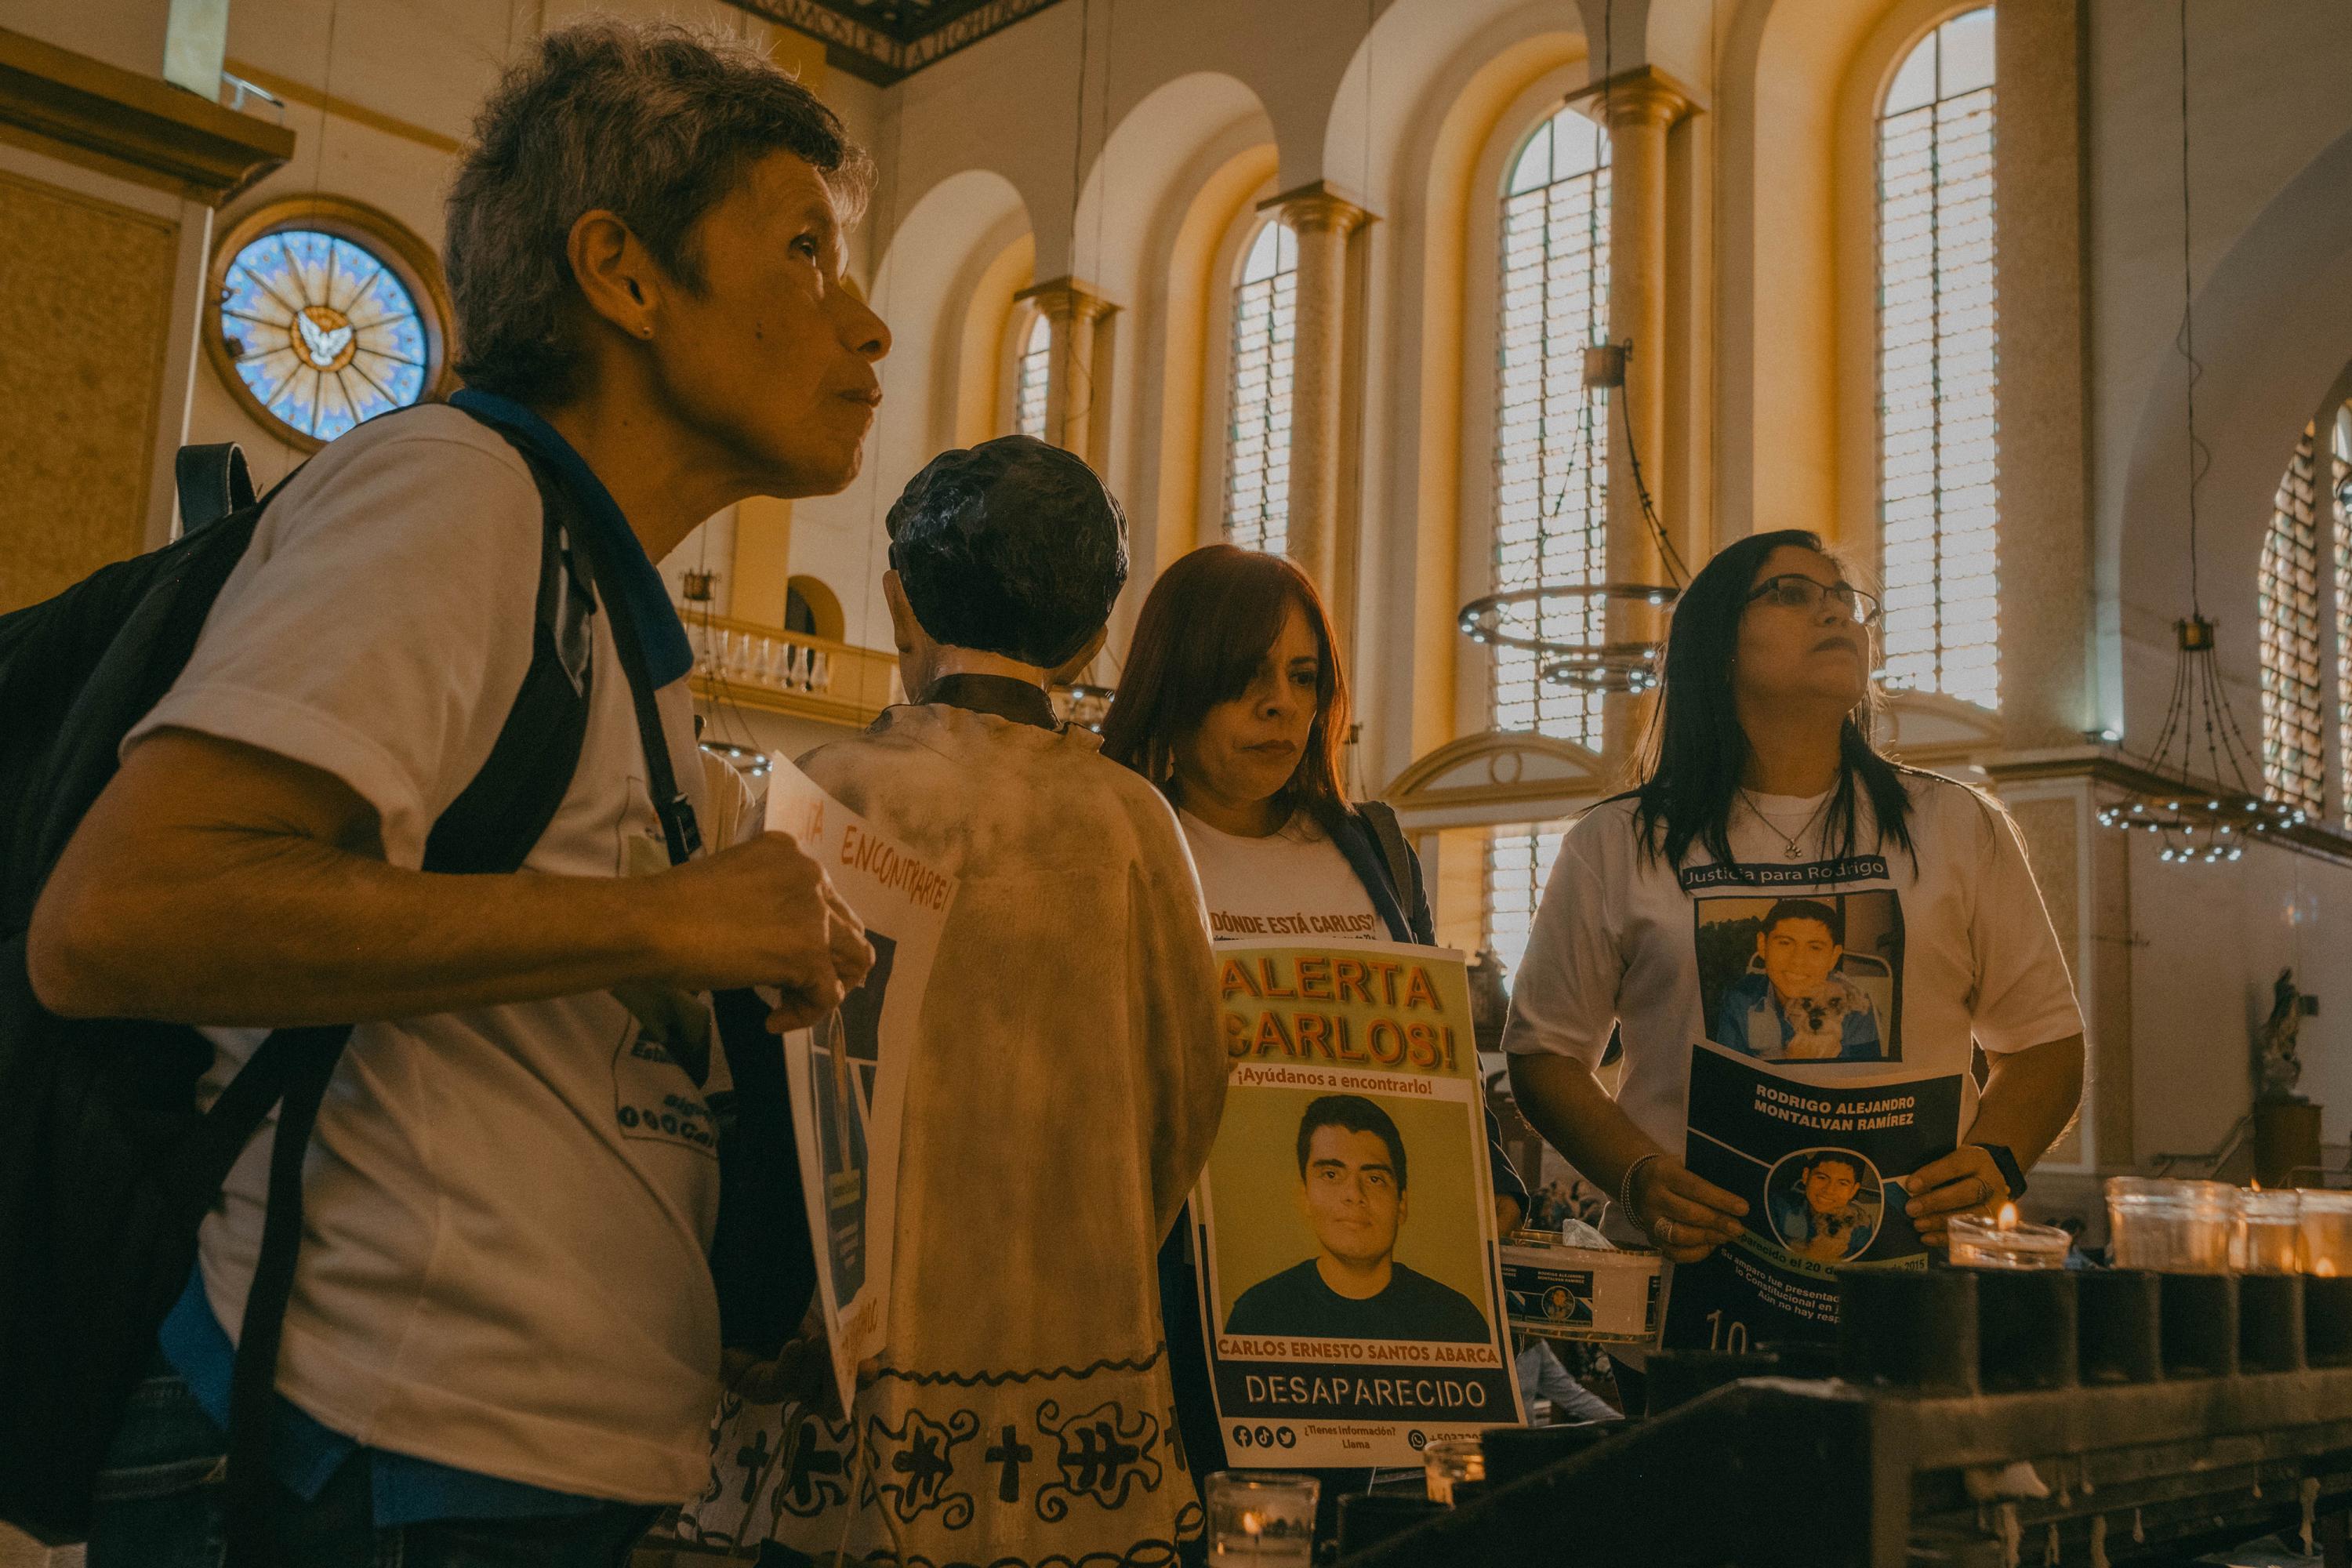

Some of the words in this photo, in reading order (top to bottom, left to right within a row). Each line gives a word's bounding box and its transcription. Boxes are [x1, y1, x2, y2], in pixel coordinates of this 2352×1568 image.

[1761, 870, 1802, 884] para
[1808, 861, 1884, 880] Rodrigo
[1210, 911, 1268, 934] DÓNDE
[1267, 913, 1311, 934] ESTÁ
[1310, 913, 1375, 934] CARLOS?
[1219, 956, 1442, 1011] ALERTA
[1237, 1068, 1325, 1087] ¡Ayúdanos
[1328, 1076, 1337, 1086] a
[1341, 1075, 1432, 1095] encontrarlo!
[1755, 1084, 1831, 1114] RODRIGO
[1835, 1096, 1915, 1115] ALEJANDRO
[1754, 1099, 1854, 1131] MONTALVAN
[1857, 1112, 1915, 1131] RAMÍREZ
[1720, 1247, 1733, 1261] Su
[1733, 1256, 1766, 1280] amparo
[1768, 1274, 1784, 1289] fue
[1790, 1258, 1802, 1268] el
[1806, 1261, 1821, 1272] 20
[1904, 1258, 1925, 1272] 2015
[1735, 1265, 1744, 1277] lo
[1745, 1272, 1817, 1309] Constitucional
[1818, 1303, 1832, 1312] en
[1757, 1290, 1777, 1306] Aún
[1778, 1300, 1792, 1312] no
[1794, 1305, 1815, 1320] hay
[1218, 1338, 1287, 1356] CARLOS
[1291, 1341, 1363, 1359] ERNESTO
[1368, 1344, 1431, 1362] SANTOS
[1435, 1345, 1499, 1364] ABARCA
[1245, 1375, 1486, 1408] DESAPARECIDO
[1342, 1439, 1370, 1450] Llama
